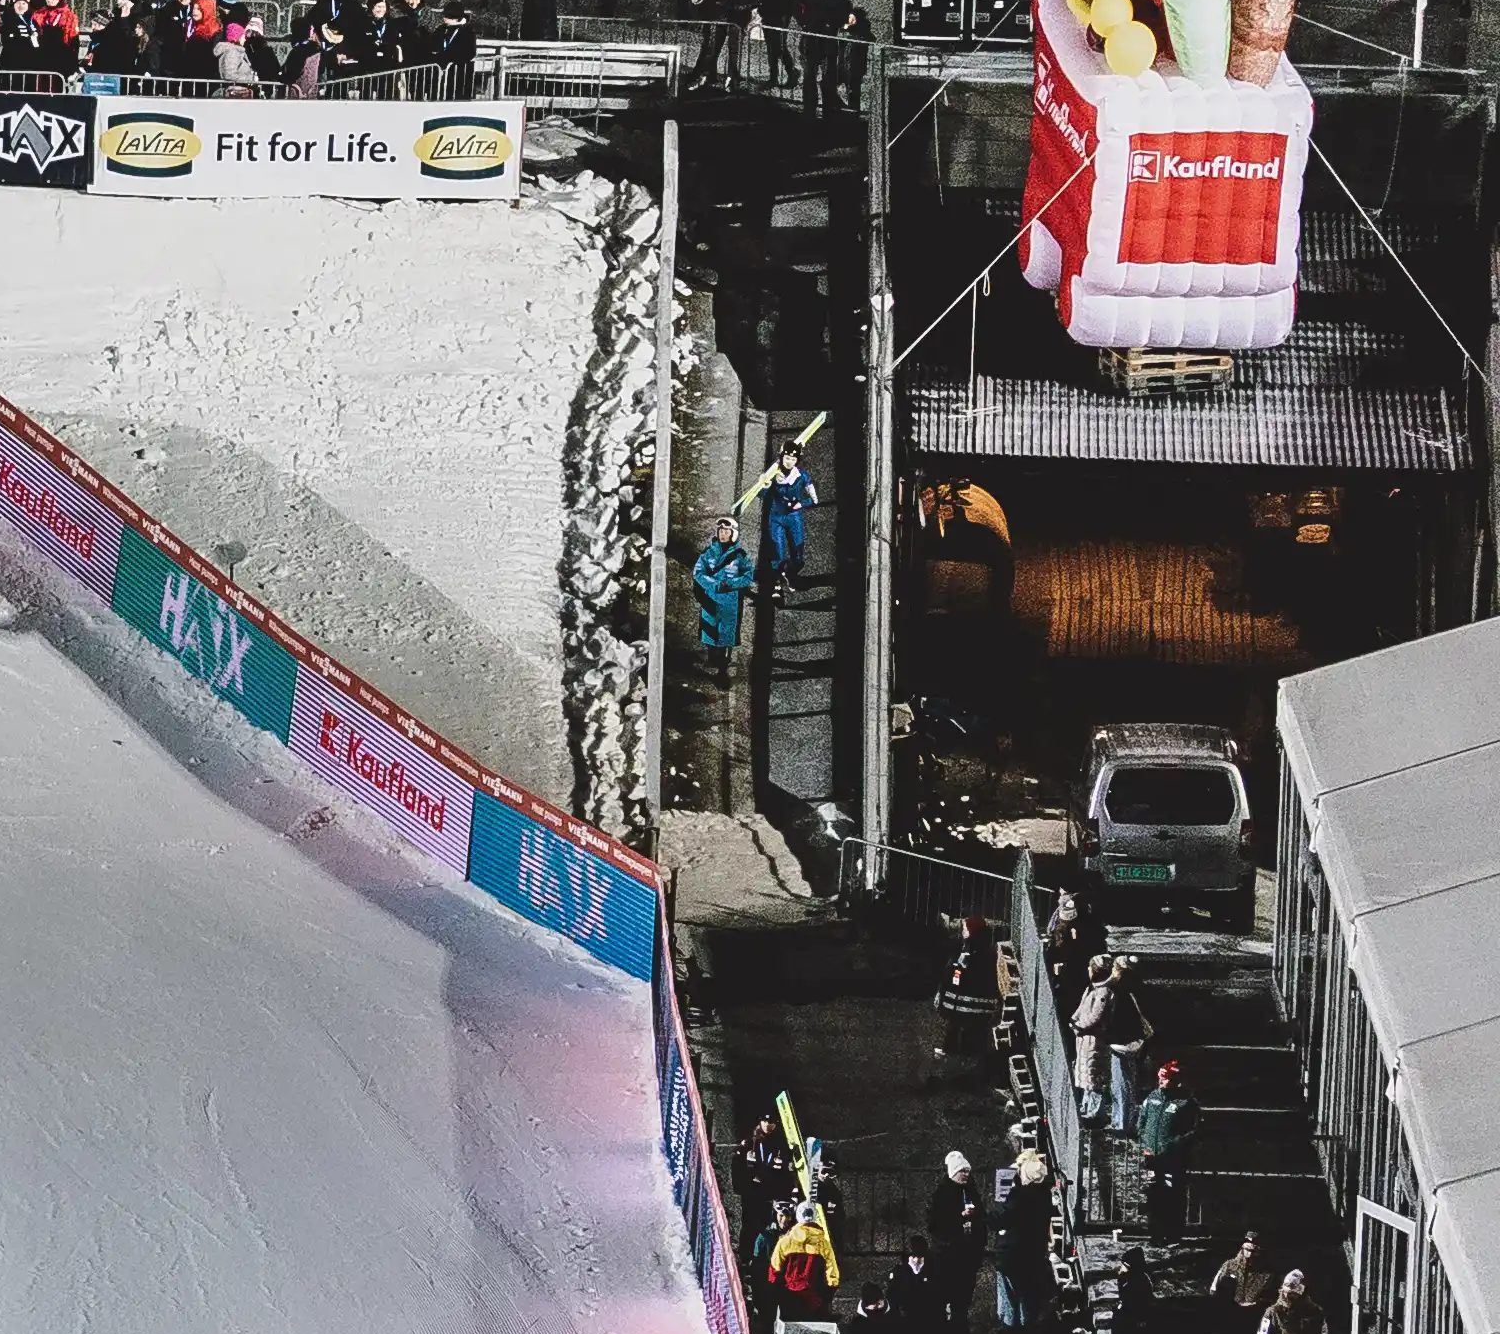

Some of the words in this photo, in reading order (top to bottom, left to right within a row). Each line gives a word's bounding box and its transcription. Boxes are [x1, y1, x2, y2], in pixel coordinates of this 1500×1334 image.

[216, 132, 259, 163] Fit
[268, 132, 317, 163] for
[327, 132, 397, 163] Life.
[1164, 155, 1280, 179] Kaufland
[0, 457, 96, 561] Kaufland
[348, 730, 445, 833] Kaufland
